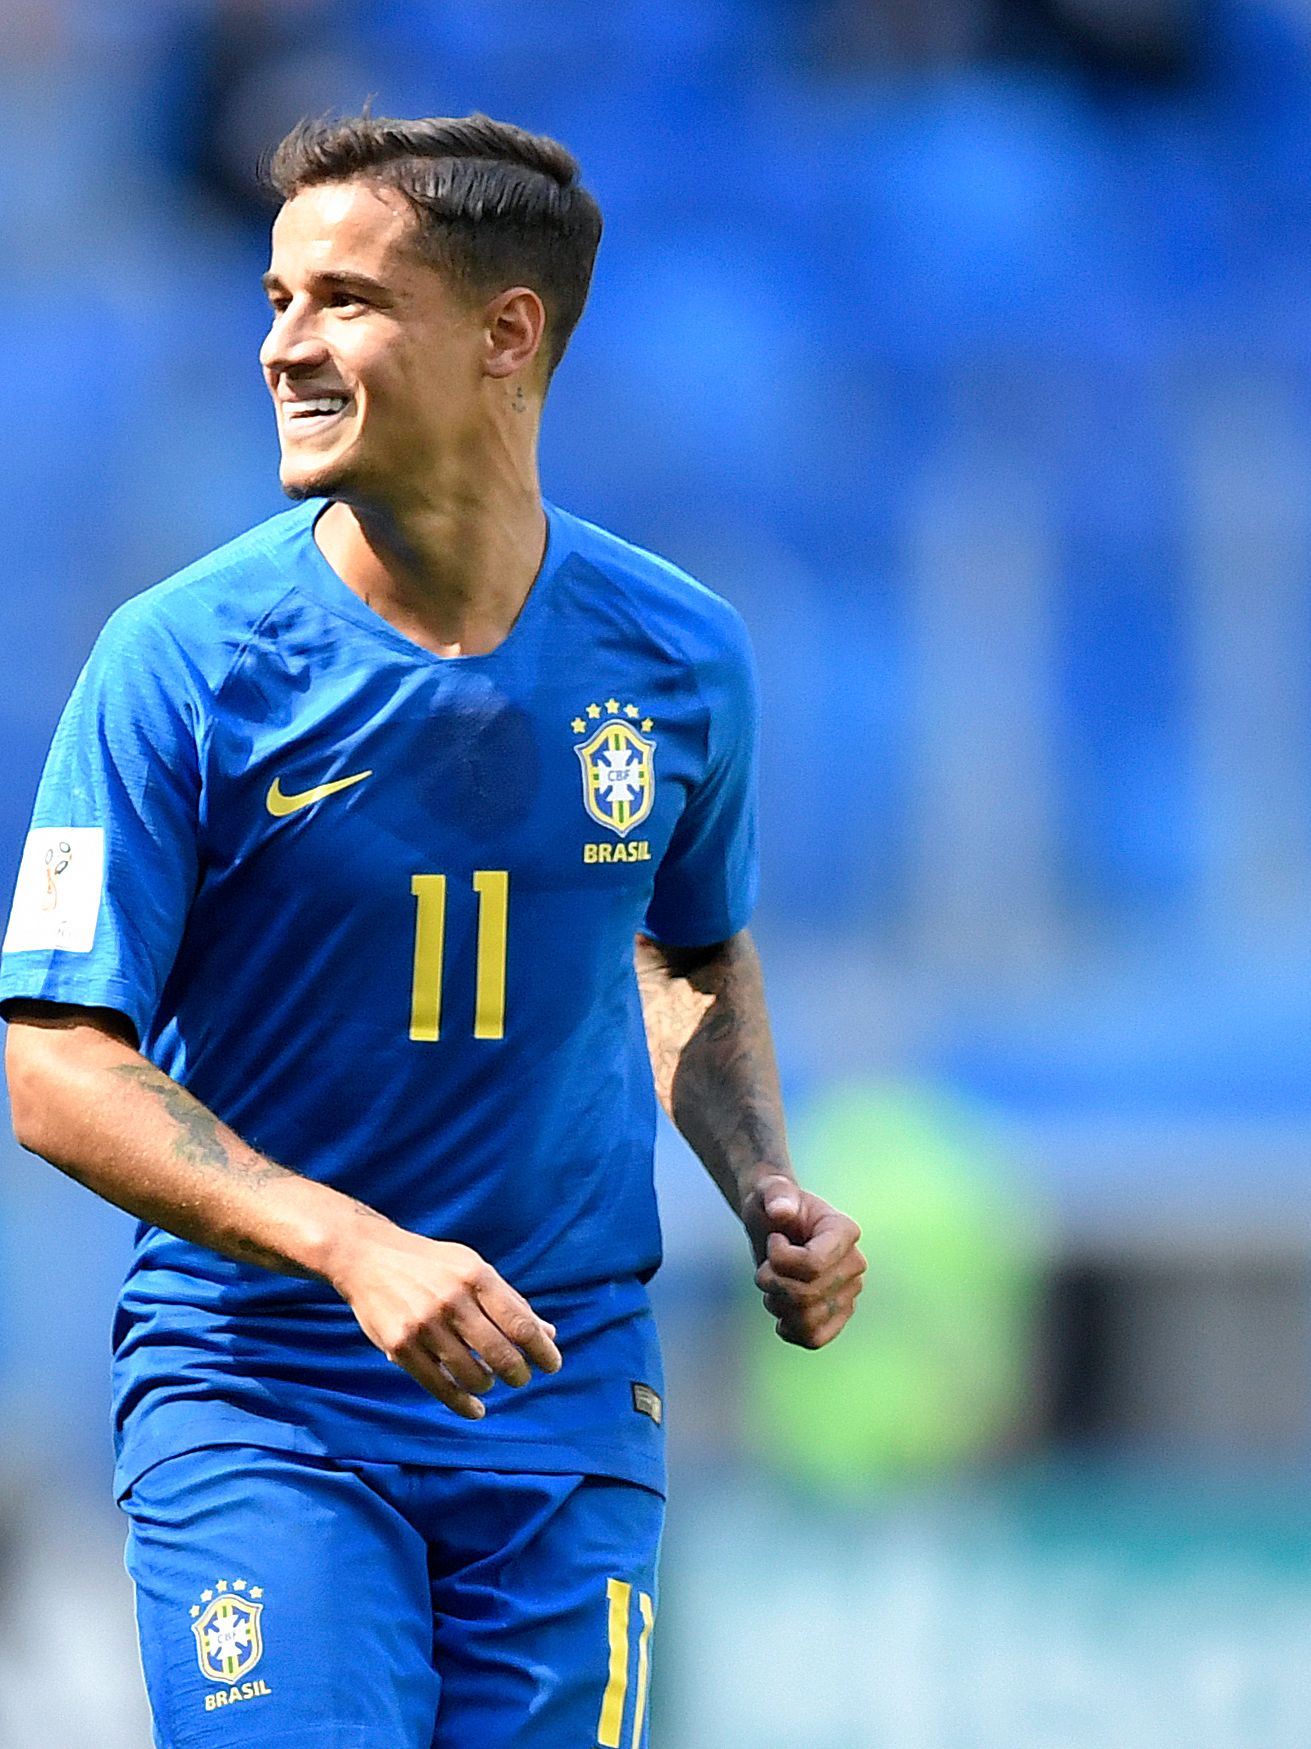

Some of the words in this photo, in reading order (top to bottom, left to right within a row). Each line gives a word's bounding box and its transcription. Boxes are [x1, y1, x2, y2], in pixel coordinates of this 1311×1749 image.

[608, 769, 631, 782] CBF
[583, 841, 652, 863] BRASIL
[409, 870, 509, 1042] 11
[204, 1679, 273, 1712] BRASIL
